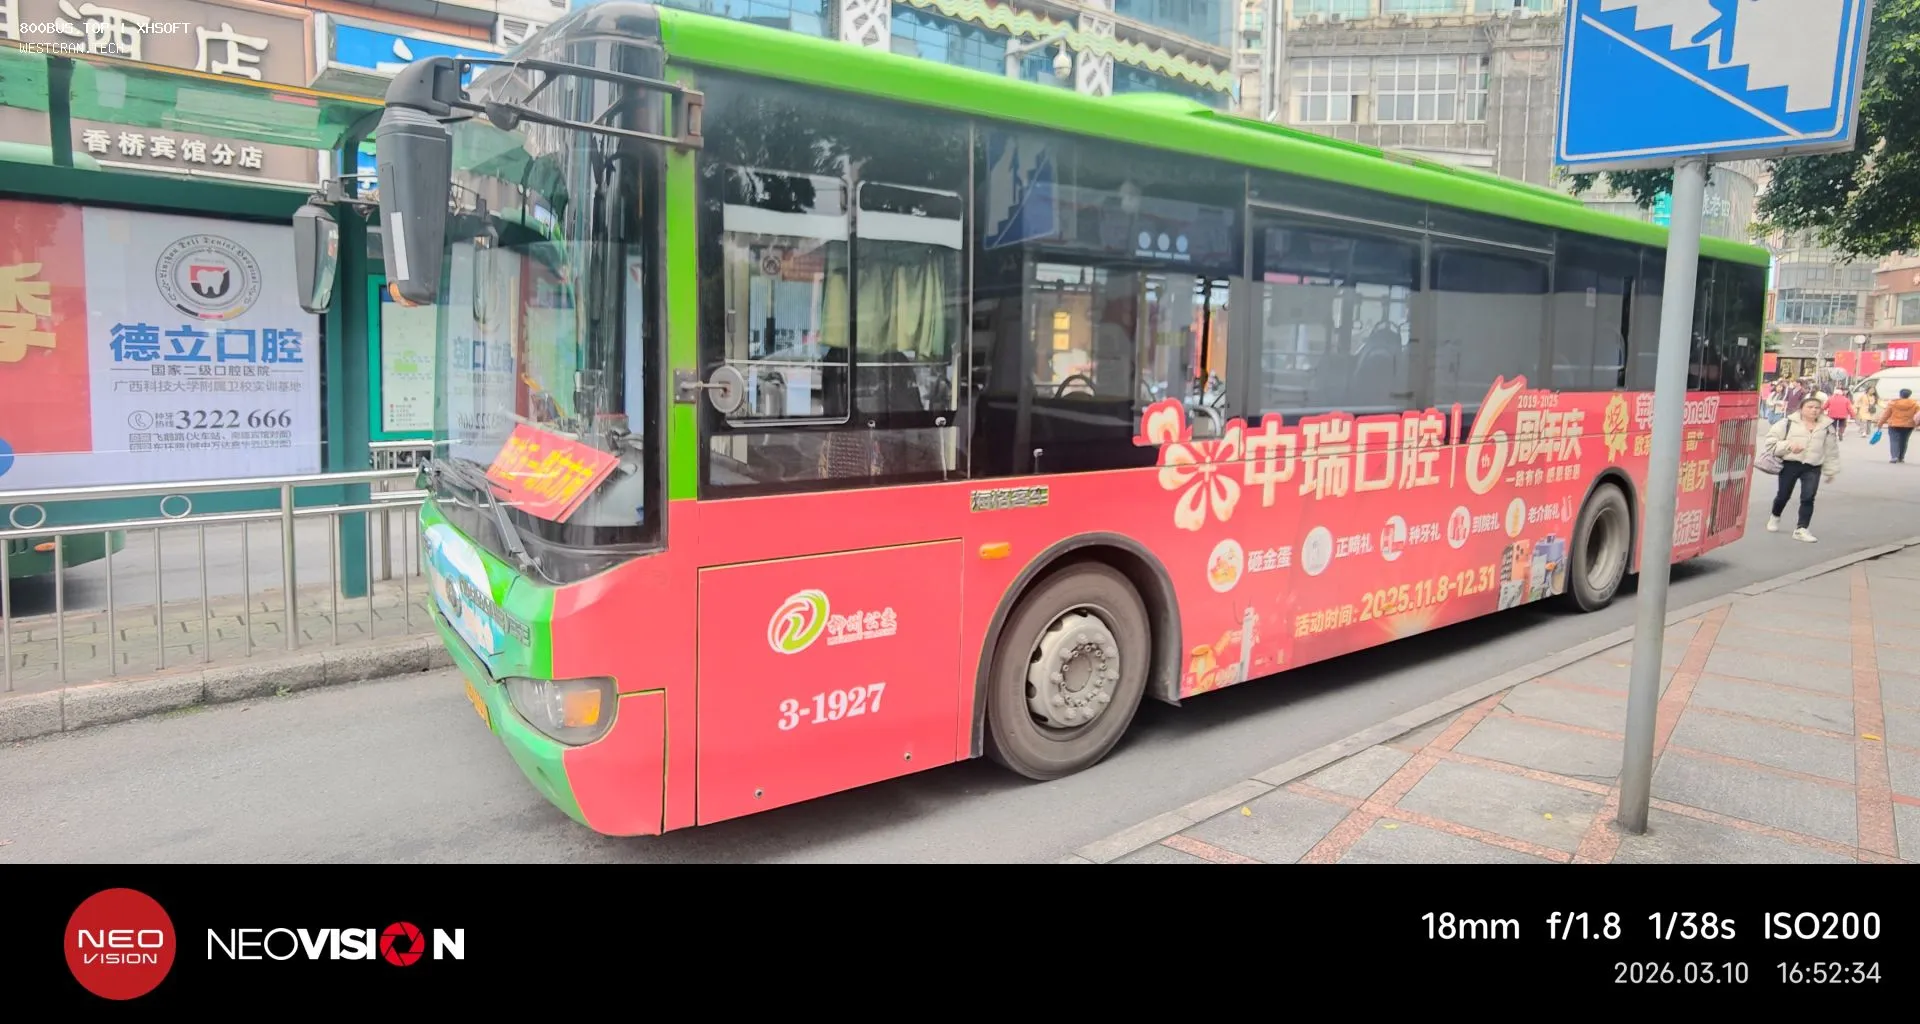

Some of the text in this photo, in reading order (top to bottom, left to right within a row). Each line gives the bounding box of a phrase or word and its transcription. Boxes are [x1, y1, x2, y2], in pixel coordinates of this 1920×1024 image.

[81, 128, 265, 170] 香桥宾馆分店
[110, 322, 304, 363] 德立口腔
[151, 364, 271, 377] 国家二级口腔医院
[176, 409, 293, 430] 3222 666
[1243, 414, 1441, 507] 中瑞口腔
[1507, 408, 1585, 467] 周年庆
[1678, 459, 1710, 494] 植牙
[1247, 545, 1293, 573] 砸金蛋
[1408, 522, 1441, 545] 种牙礼
[1359, 563, 1496, 623] 2025.11.8-12.31
[778, 682, 886, 731] 3-1927
